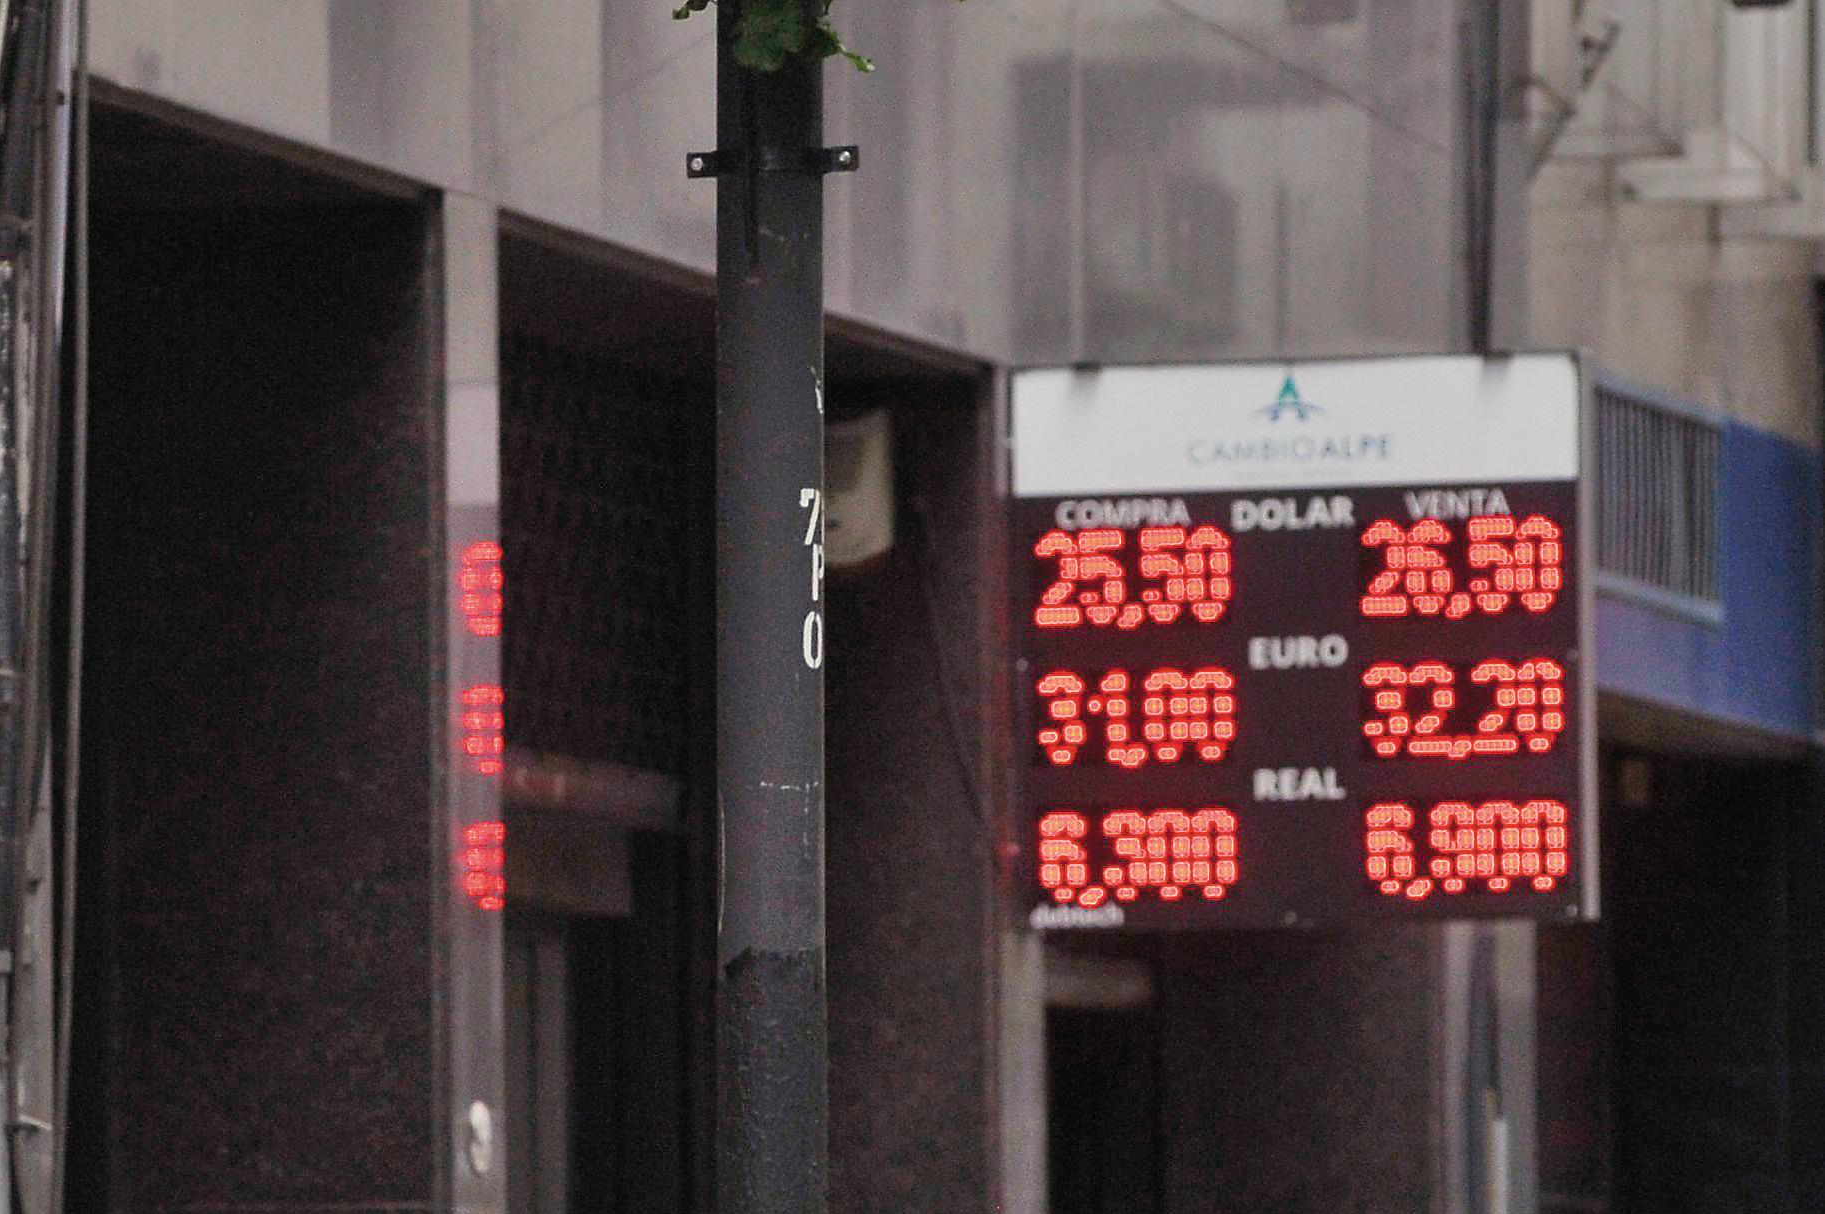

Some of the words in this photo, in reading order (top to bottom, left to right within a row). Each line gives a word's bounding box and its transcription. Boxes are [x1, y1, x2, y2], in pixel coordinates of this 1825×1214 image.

[1056, 499, 1192, 529] COMPRA
[1230, 496, 1354, 531] DOLAR
[1404, 488, 1510, 520] VENTA
[1248, 635, 1349, 669] EURO
[1253, 767, 1346, 801] REAL
